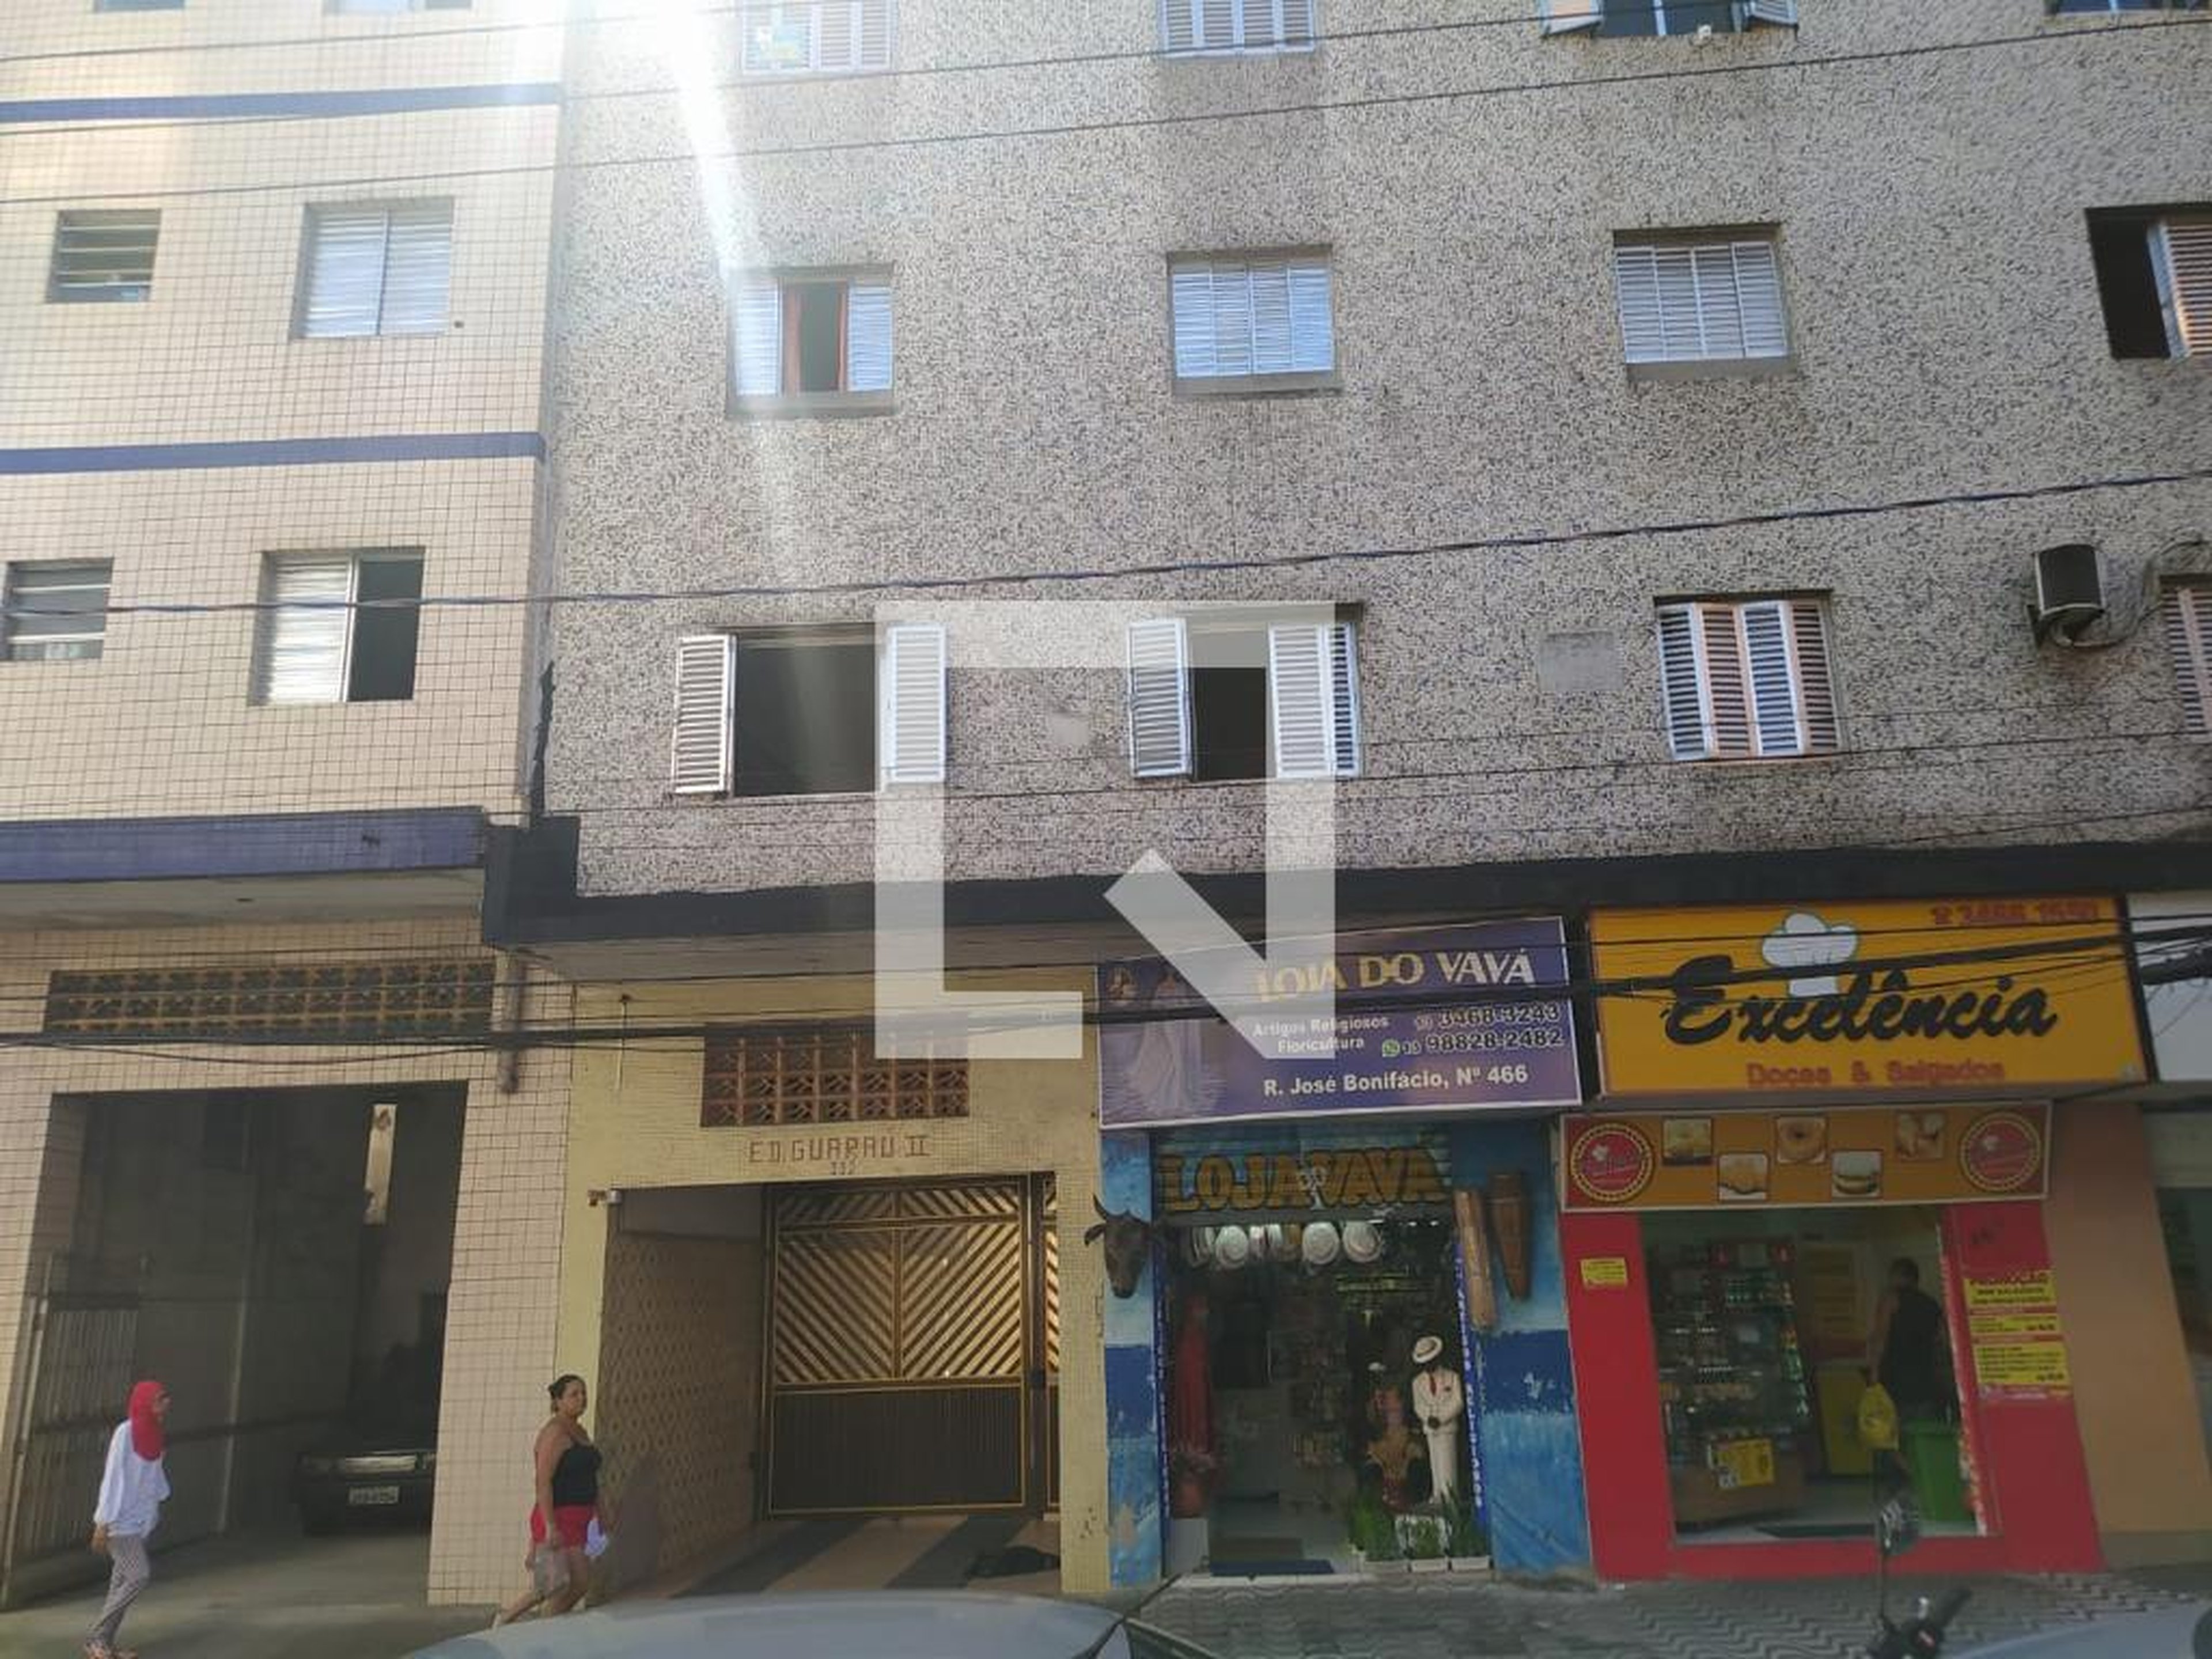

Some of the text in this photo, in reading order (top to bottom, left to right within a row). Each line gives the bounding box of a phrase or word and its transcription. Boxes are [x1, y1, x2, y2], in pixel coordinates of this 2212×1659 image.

[1359, 953, 1425, 988] DO
[1437, 946, 1535, 984] VAVÁ
[1660, 955, 2058, 1045] Excelência
[1310, 1014, 1389, 1033] Religiosos
[1264, 1080, 1282, 1097] R.
[1291, 1074, 1336, 1095] José
[1344, 1069, 1449, 1092] Bonifácio,
[1487, 1064, 1529, 1085] 466
[1851, 1060, 1871, 1081] &
[1159, 1153, 1311, 1212] LOJA
